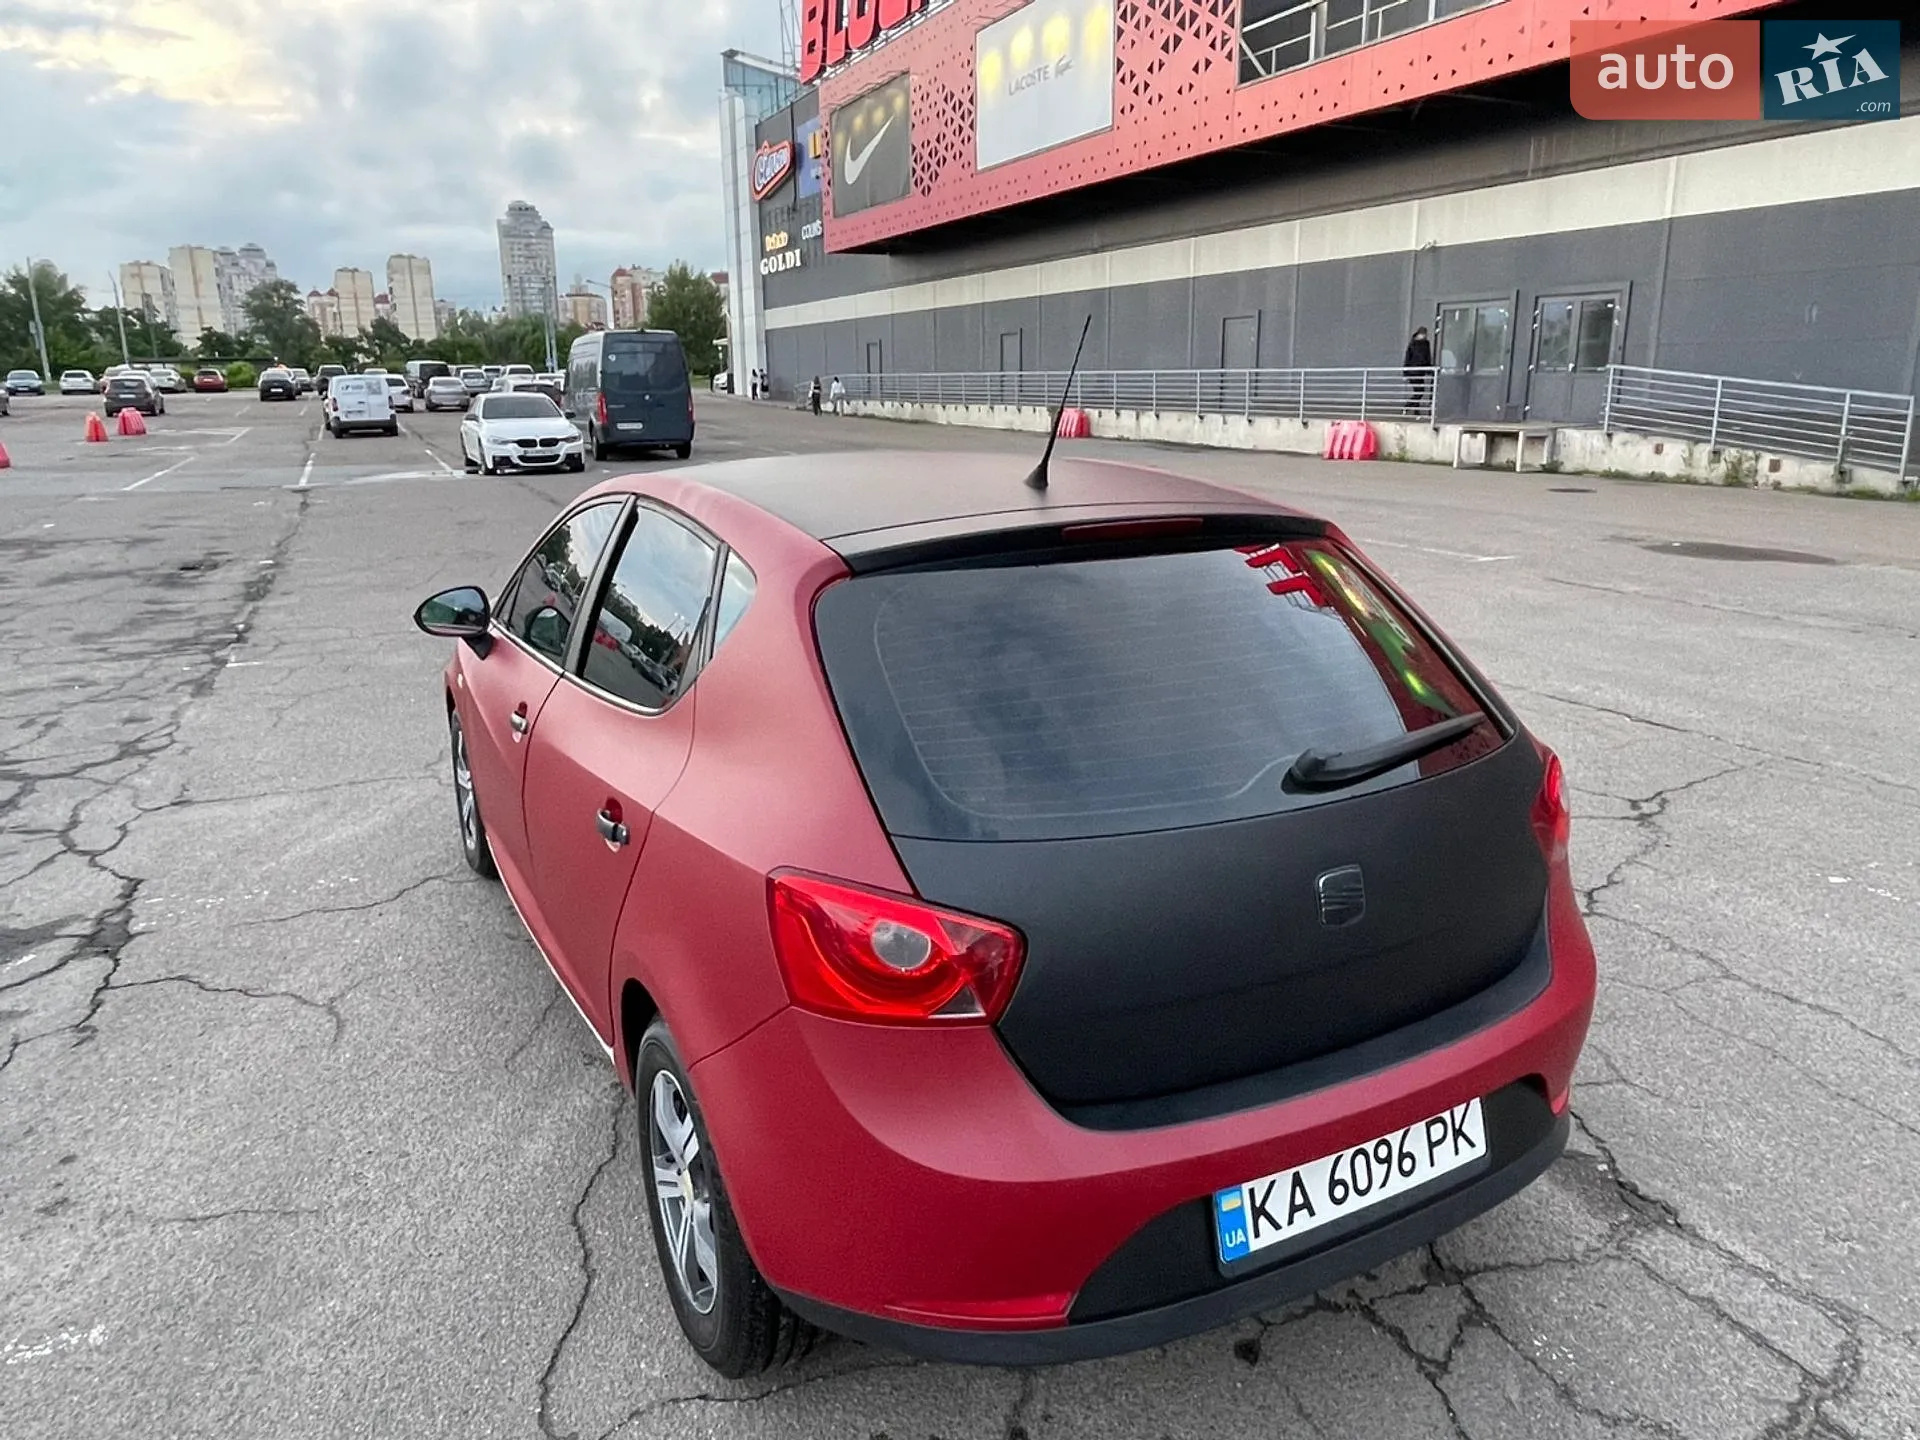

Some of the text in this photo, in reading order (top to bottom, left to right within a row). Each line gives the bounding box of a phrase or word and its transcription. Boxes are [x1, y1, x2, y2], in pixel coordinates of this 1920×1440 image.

[801, 0, 923, 84] BLO
[1008, 64, 1050, 96] LACOSTE
[760, 248, 802, 275] GOLDI
[1248, 1099, 1476, 1239] KA 6096 PK
[1225, 1227, 1247, 1249] UA
